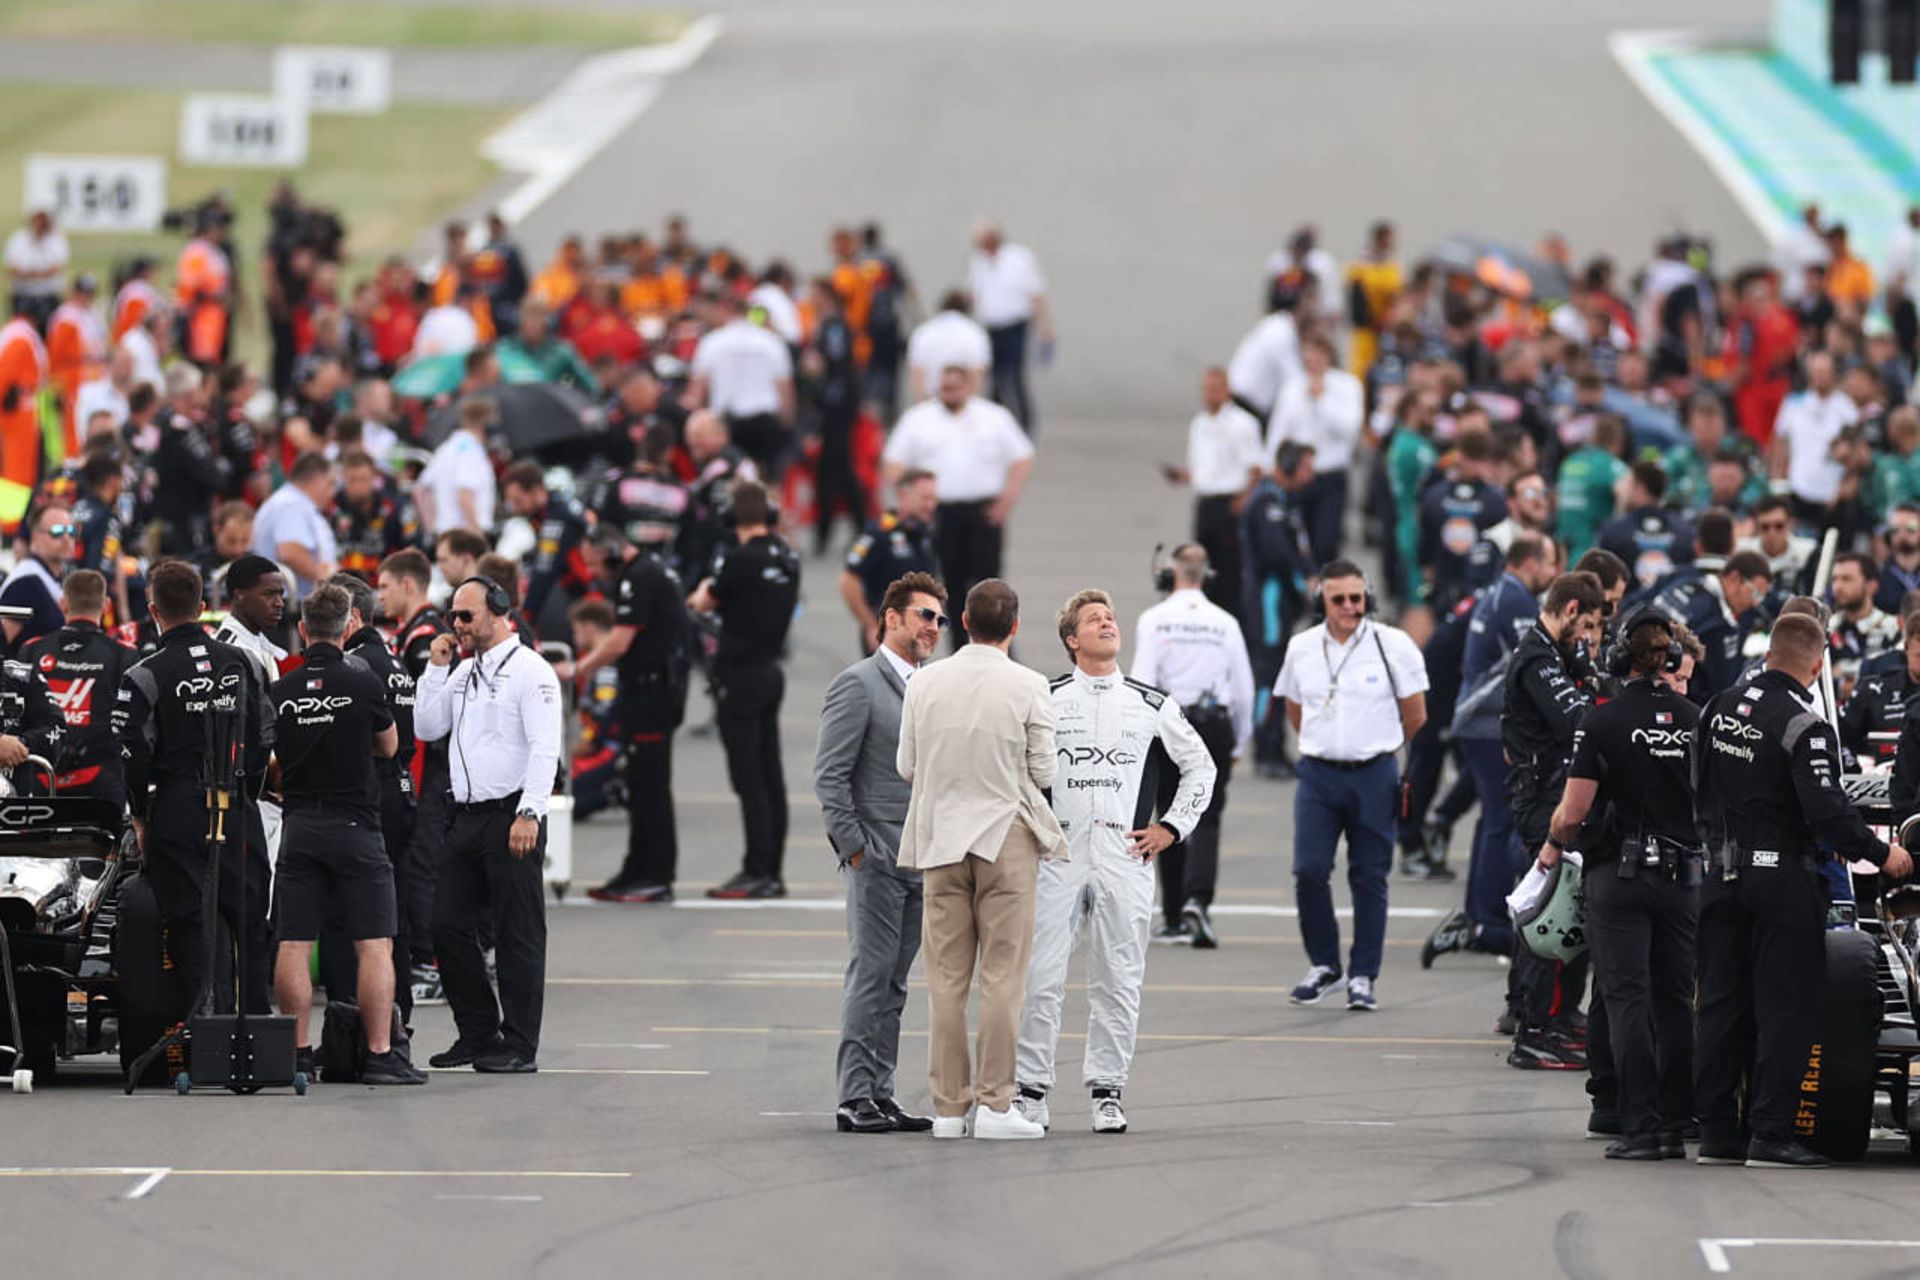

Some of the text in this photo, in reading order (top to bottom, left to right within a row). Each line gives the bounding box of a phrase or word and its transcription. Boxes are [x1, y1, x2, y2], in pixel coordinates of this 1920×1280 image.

[54, 174, 138, 214] 150
[57, 661, 104, 671] MoneyGram
[297, 714, 335, 726] Expensify
[1649, 748, 1685, 759] Expensify
[1712, 736, 1755, 763] Expensify
[1067, 778, 1123, 793] Expensify
[1752, 853, 1779, 865] OMP
[1794, 1099, 1817, 1134] LEFT
